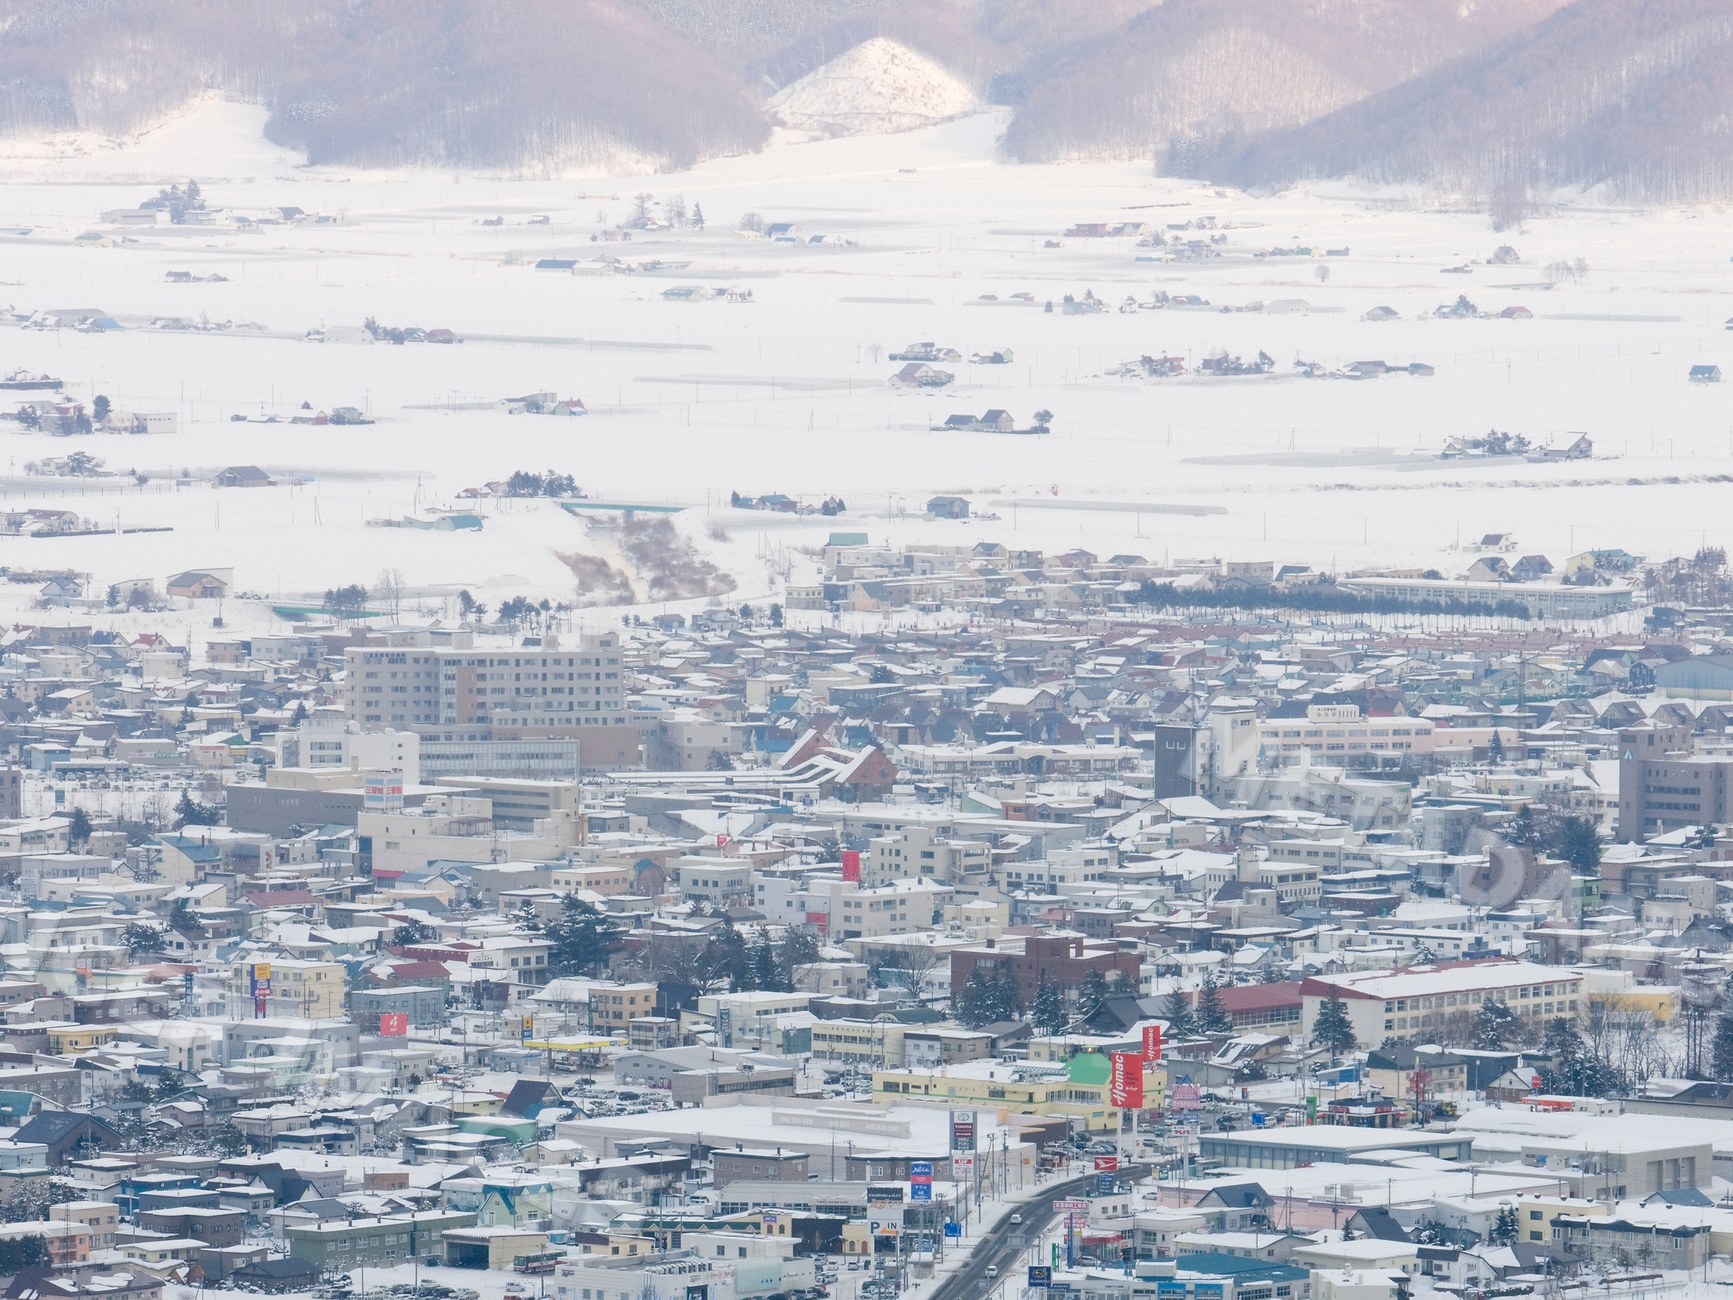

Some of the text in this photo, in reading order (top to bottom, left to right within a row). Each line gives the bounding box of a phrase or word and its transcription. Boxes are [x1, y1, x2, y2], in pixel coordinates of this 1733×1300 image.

[1147, 1027, 1157, 1061] Homac
[1112, 1054, 1128, 1106] Homac
[870, 1221, 880, 1234] P
